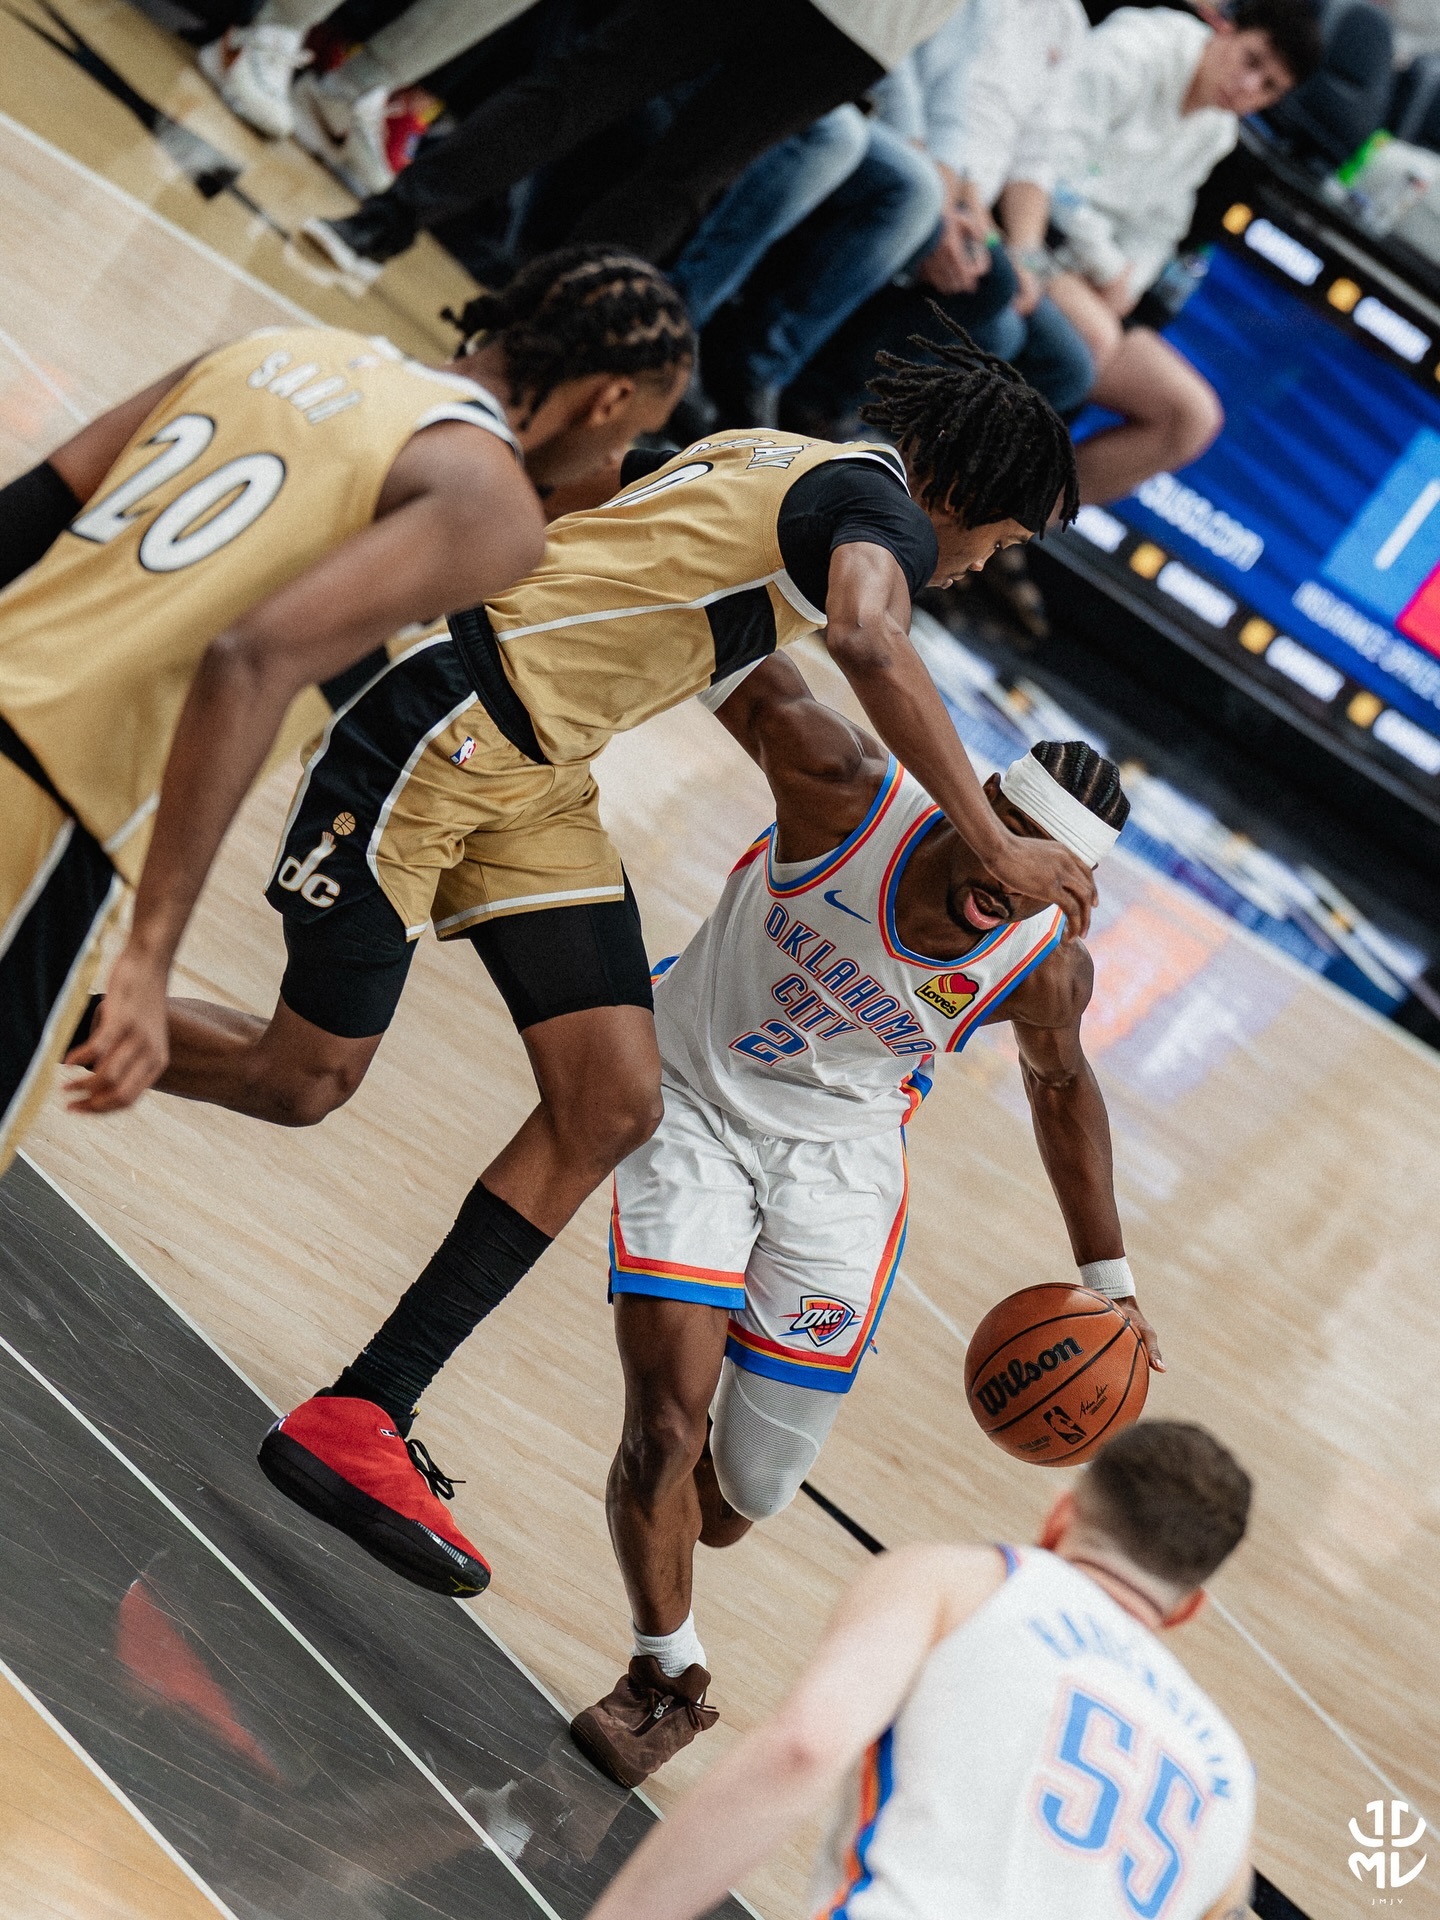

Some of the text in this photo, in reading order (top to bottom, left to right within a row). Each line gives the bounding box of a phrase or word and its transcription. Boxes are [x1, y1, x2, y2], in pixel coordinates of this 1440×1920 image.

[70, 412, 287, 573] 20
[763, 902, 937, 1057] OKLAHOMA
[771, 973, 862, 1041] CITY
[728, 1018, 809, 1066] 2
[790, 1308, 845, 1331] OKC
[975, 1336, 1084, 1418] Wilson
[1034, 1682, 1206, 1920] 55
